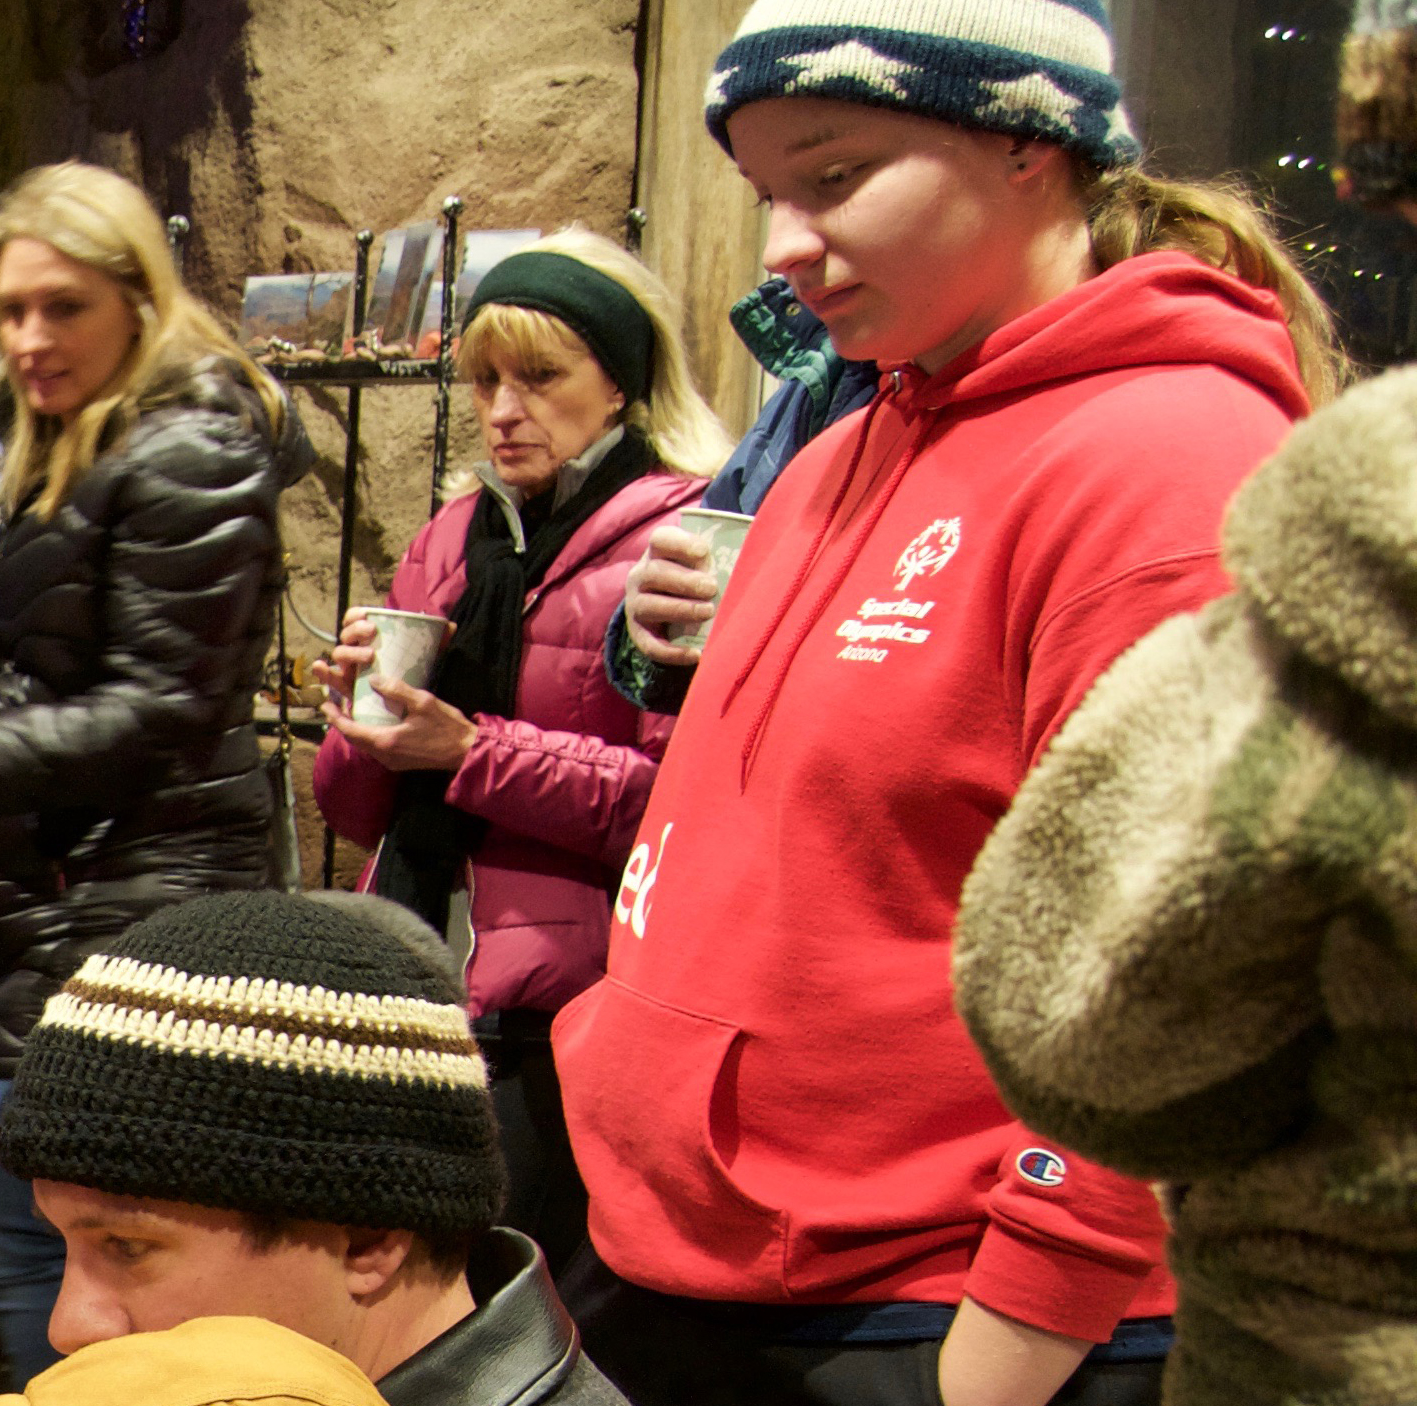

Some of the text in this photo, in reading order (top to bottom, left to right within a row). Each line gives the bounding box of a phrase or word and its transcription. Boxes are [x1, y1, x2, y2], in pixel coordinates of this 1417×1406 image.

[857, 598, 935, 620] Special
[836, 620, 931, 644] Olympics
[836, 644, 888, 663] Arizona
